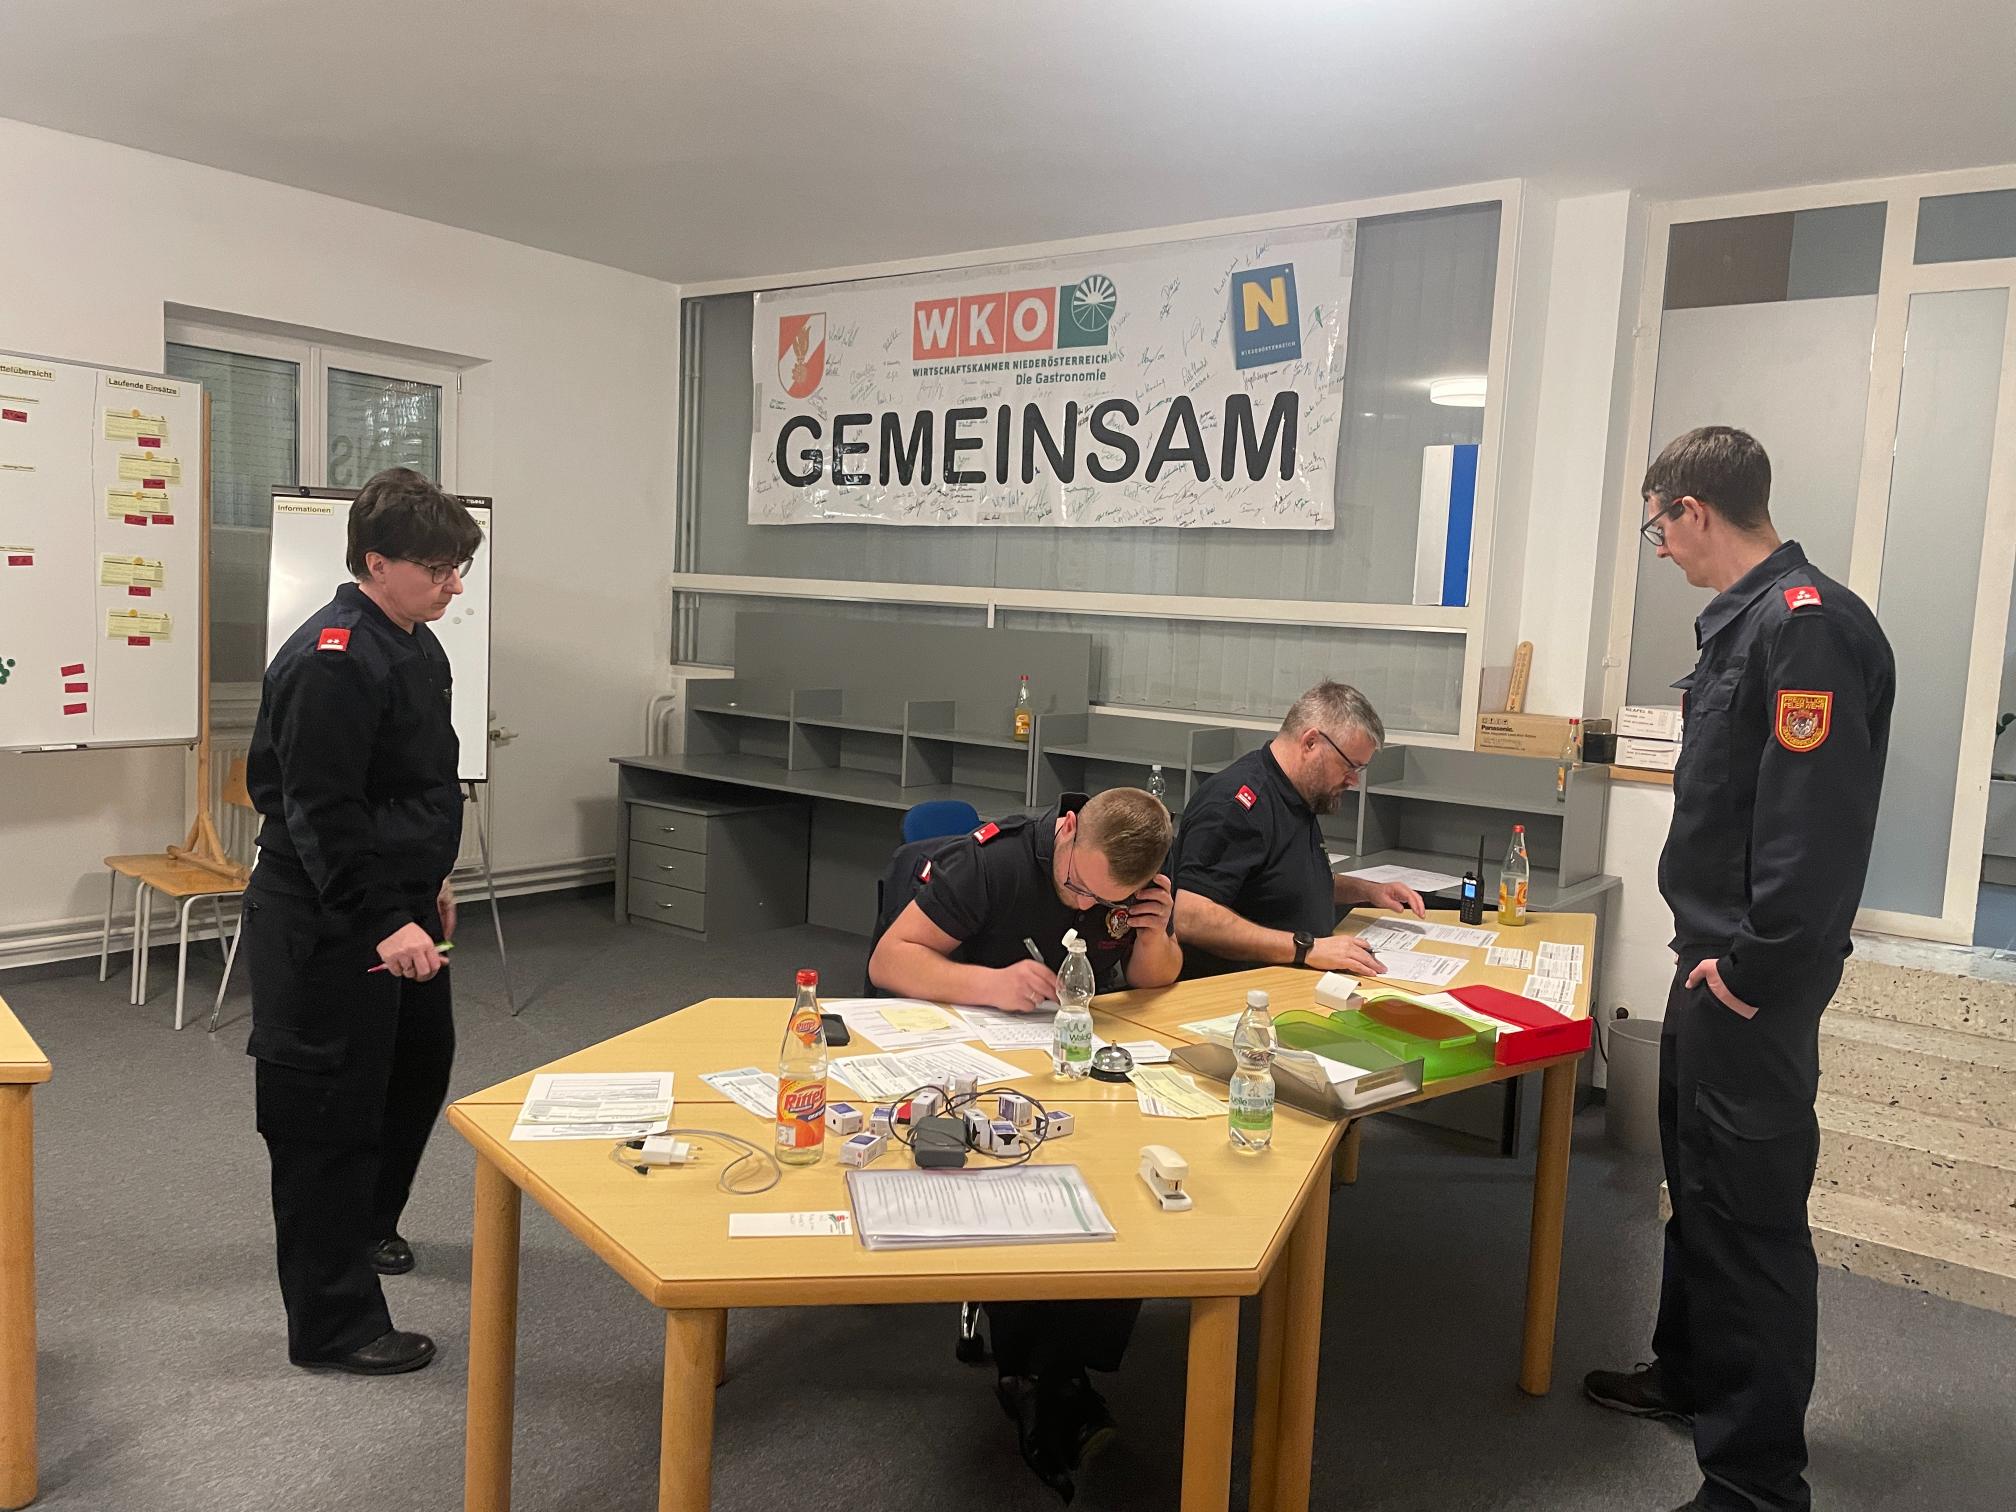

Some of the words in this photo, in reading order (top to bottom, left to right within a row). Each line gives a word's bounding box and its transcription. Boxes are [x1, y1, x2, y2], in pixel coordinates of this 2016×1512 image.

[1243, 277, 1289, 332] N
[917, 297, 1048, 350] WKO
[912, 361, 1010, 377] WIRTSCHAFTSKAMMER
[1012, 354, 1108, 370] NIEDERÖSTERREICH
[109, 378, 144, 391] Laufende
[146, 384, 177, 395] Einsätze
[1016, 373, 1032, 386] Die
[1035, 369, 1106, 385] Gastronomie
[776, 391, 1299, 487] GEMEINSAM
[277, 504, 332, 514] Informationen
